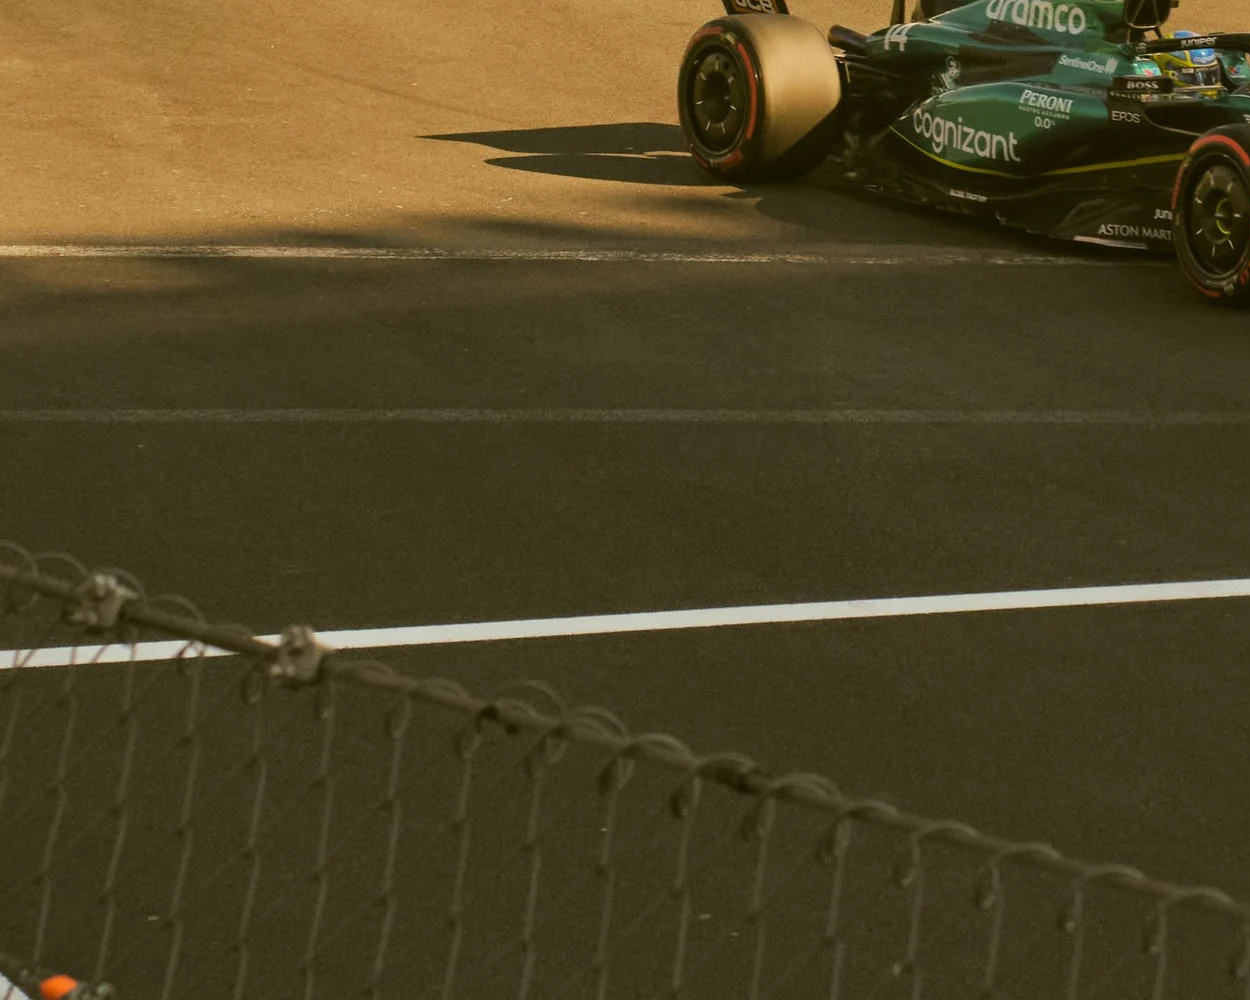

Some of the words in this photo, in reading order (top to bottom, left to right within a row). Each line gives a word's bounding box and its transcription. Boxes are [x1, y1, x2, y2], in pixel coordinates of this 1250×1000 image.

[1058, 54, 1104, 74] SentinelOne
[1126, 80, 1160, 90] BOSS
[1019, 90, 1074, 113] PERONI
[1112, 110, 1141, 124] EPOS
[914, 108, 1021, 162] cognizant
[1098, 223, 1140, 237] ASTON
[1142, 227, 1173, 241] MART
